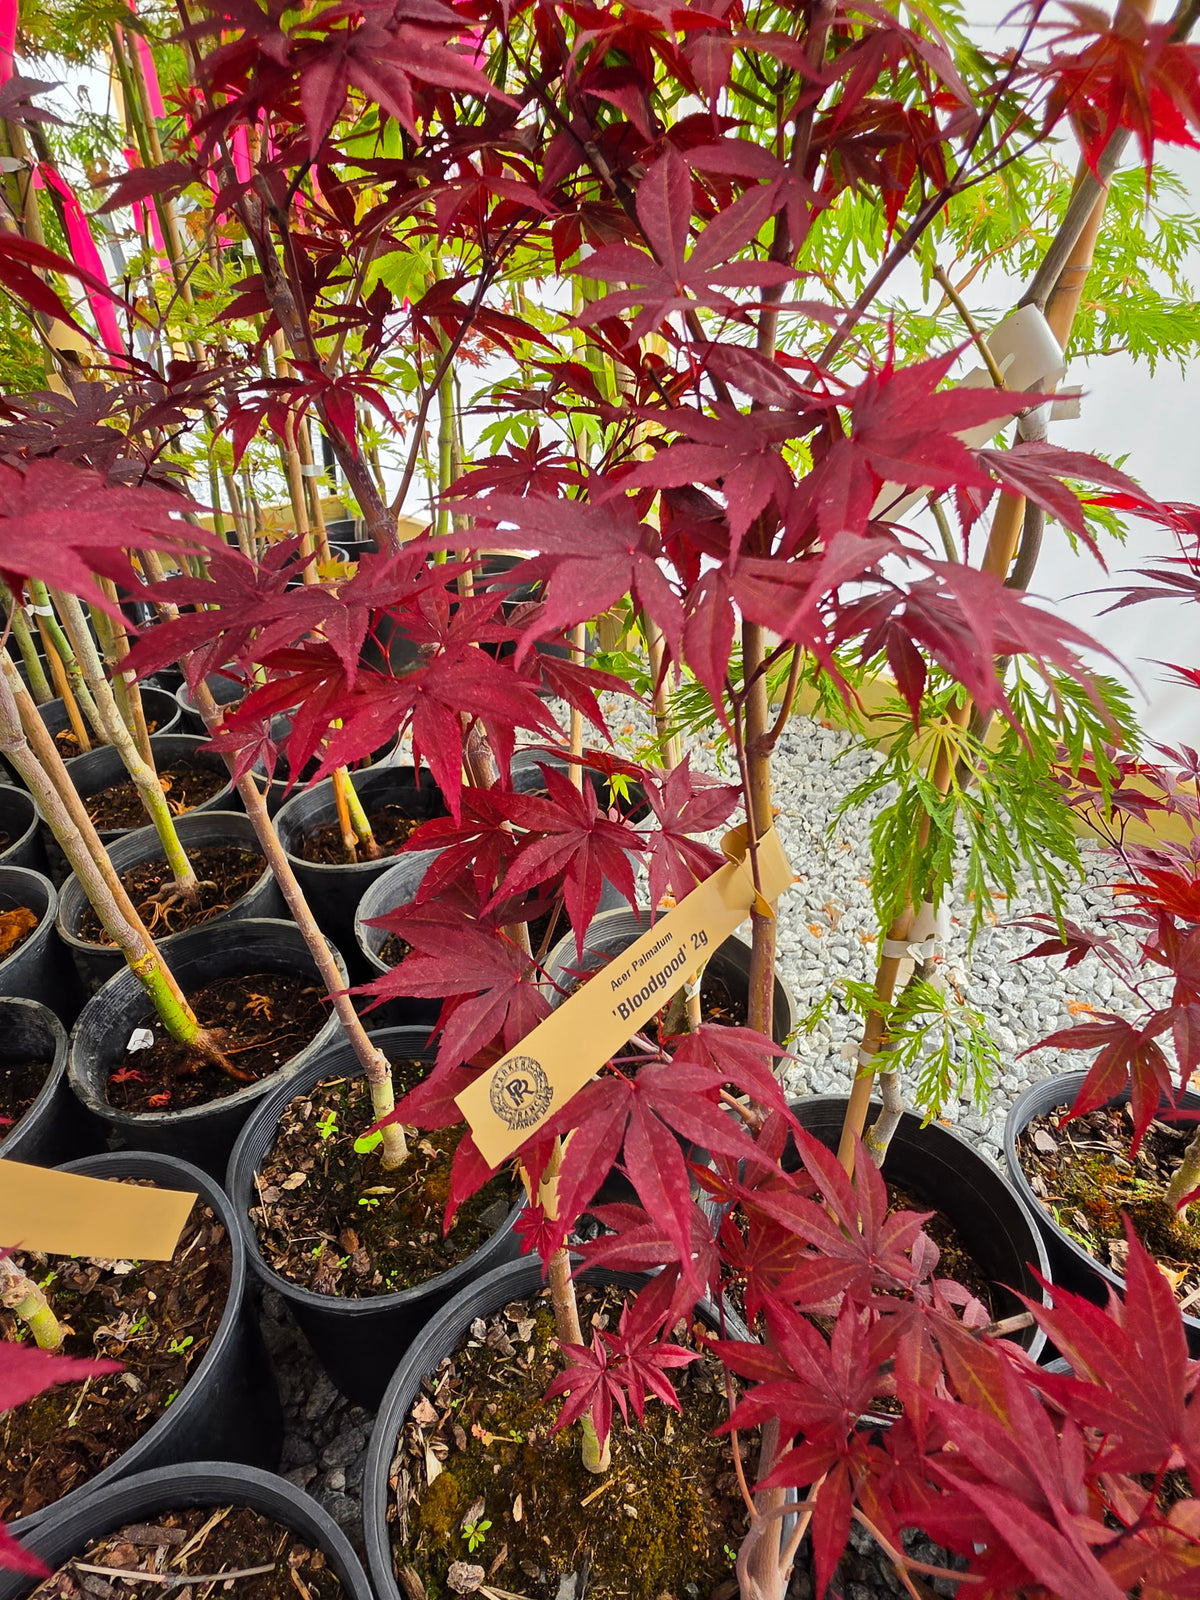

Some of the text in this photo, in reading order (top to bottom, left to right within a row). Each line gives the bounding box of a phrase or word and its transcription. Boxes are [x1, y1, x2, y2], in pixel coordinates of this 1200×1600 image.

[610, 932, 673, 991] Acer Palmatum
[612, 929, 708, 1021] 'Bloodgood' 2g
[495, 1060, 526, 1088] PARKER
[517, 1093, 543, 1119] RANCH
